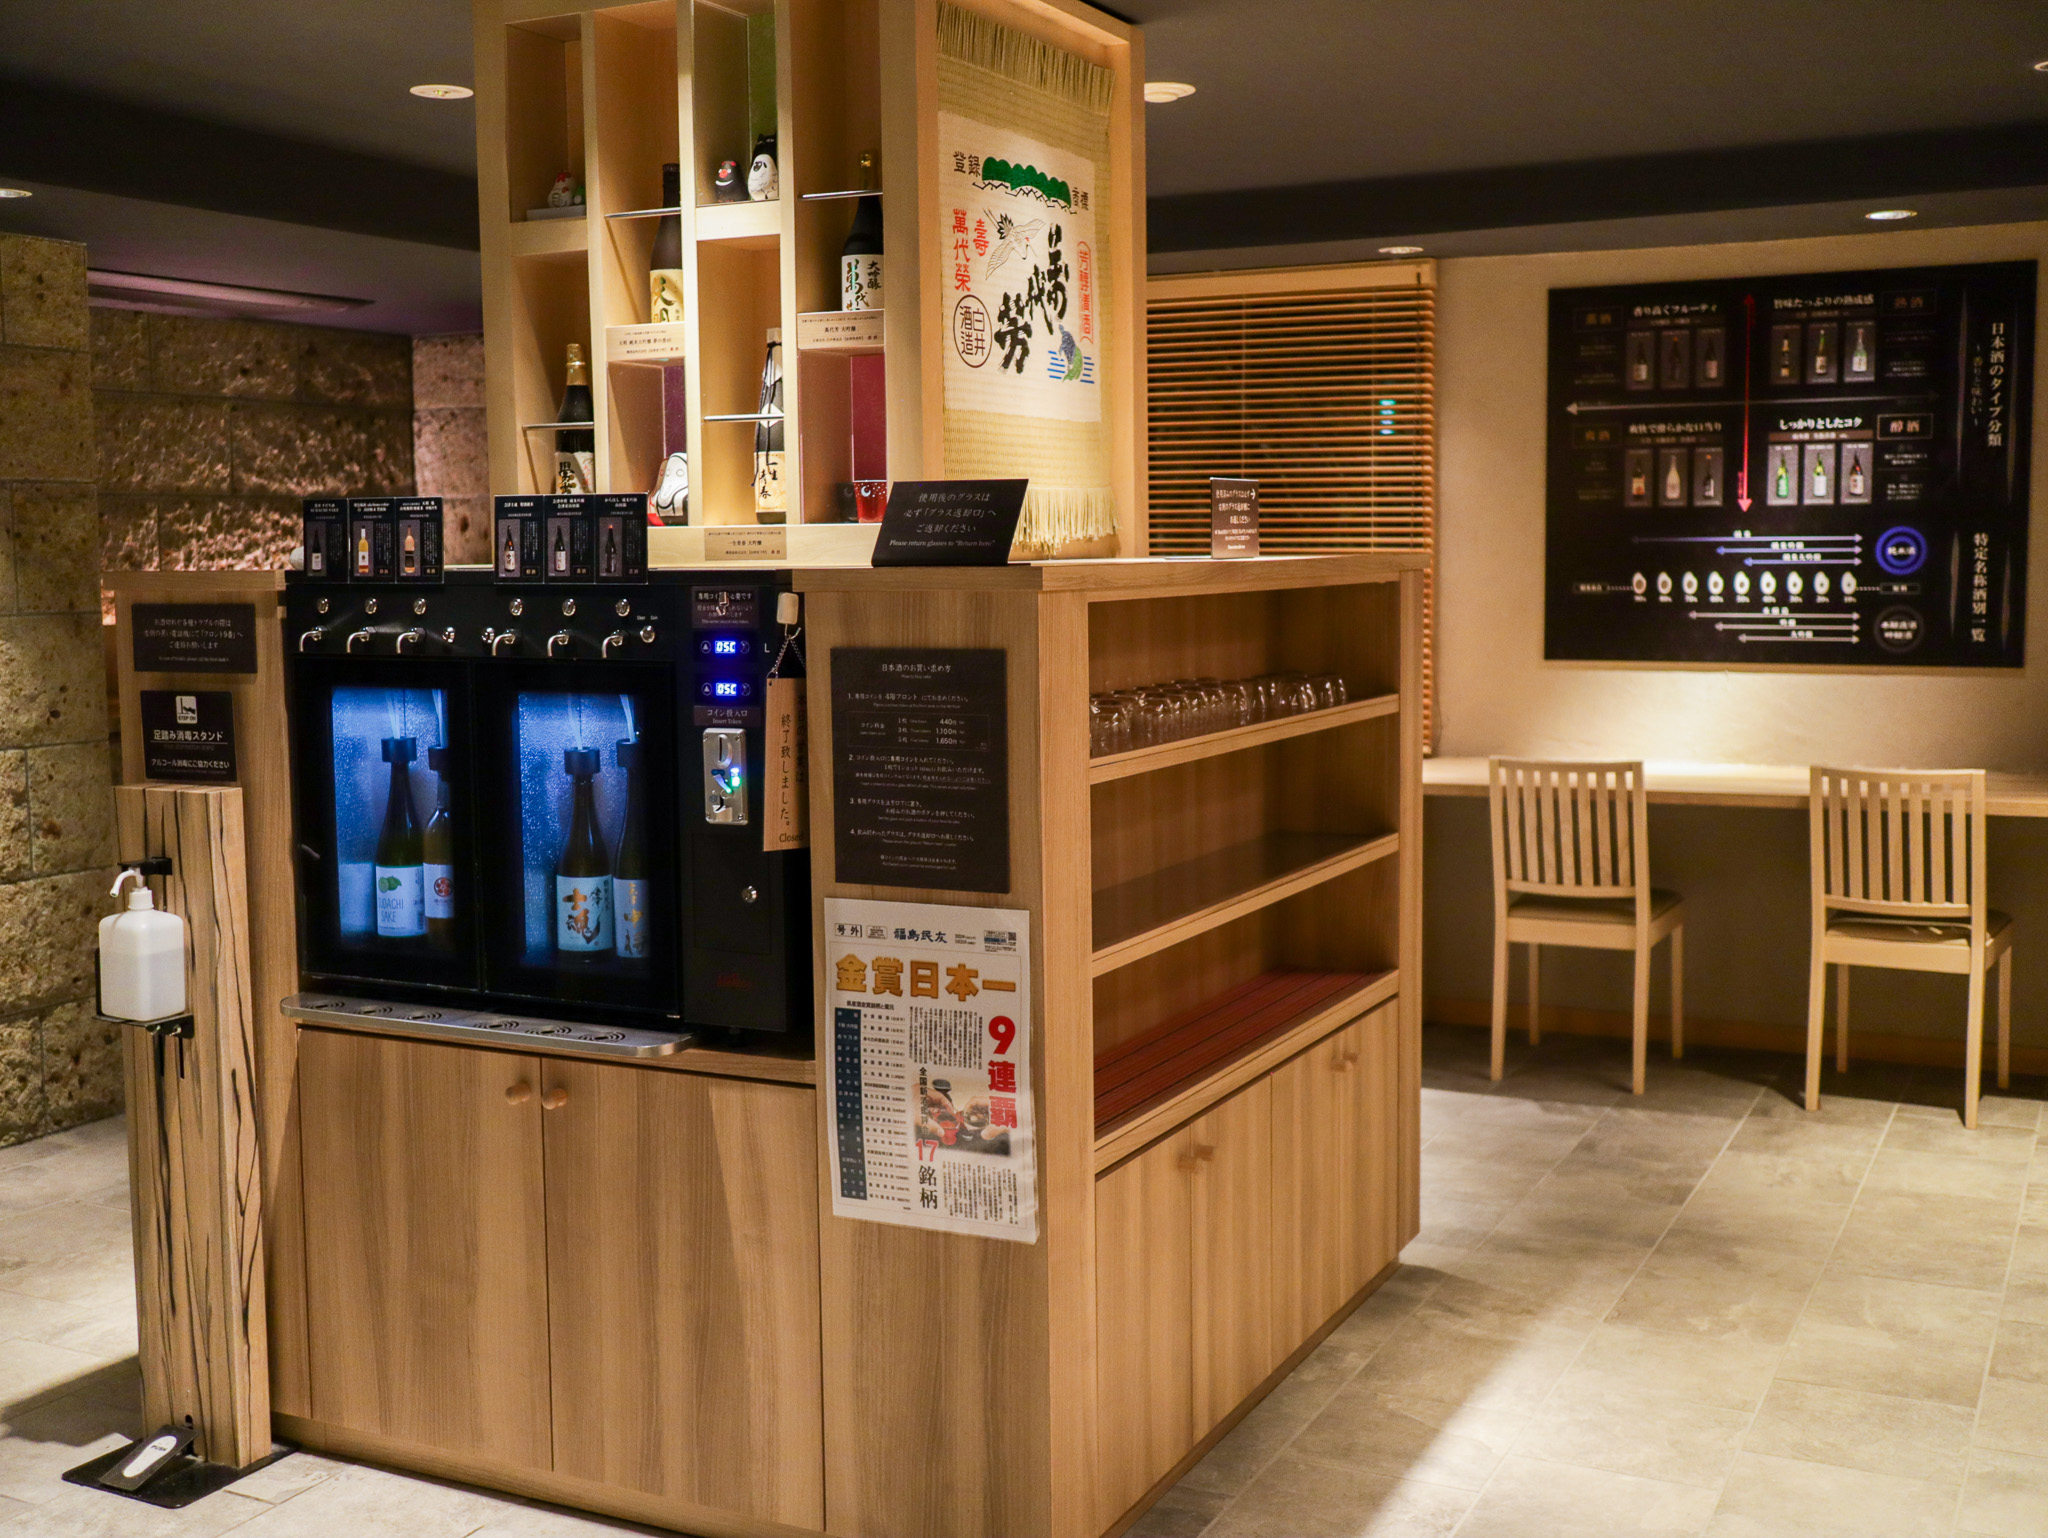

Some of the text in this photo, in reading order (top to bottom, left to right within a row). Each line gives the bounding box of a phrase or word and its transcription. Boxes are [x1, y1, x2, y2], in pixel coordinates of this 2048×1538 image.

[953, 151, 982, 178] 登録
[1773, 294, 1875, 309] 旨味たっぷりの熟成感
[1633, 304, 1717, 318] 香り高くフルーティ
[1987, 322, 2006, 447] 日本酒のタイプ分類
[1779, 417, 1863, 430] しっかりとしたコク
[918, 492, 990, 503] 使用後のグラスは
[916, 524, 976, 533] ご返却ください
[889, 539, 908, 547] Please
[927, 540, 947, 548] glasses
[1971, 532, 1989, 643] 特定名称酒別一覧
[881, 663, 952, 673] 日本酒のお買い求め方
[707, 709, 748, 717] コイン投入口
[153, 730, 224, 742] 足踏み消毒スタンド
[151, 759, 230, 769] アルコール消毒にご協力ください
[780, 713, 792, 826] 終了致しました。
[779, 832, 804, 843] Closed
[381, 911, 396, 922] SAKE
[837, 924, 861, 937] 号外
[893, 928, 948, 944] 福島民友
[836, 954, 1016, 1002] 金賞日本一
[988, 1015, 1018, 1130] 9連覇
